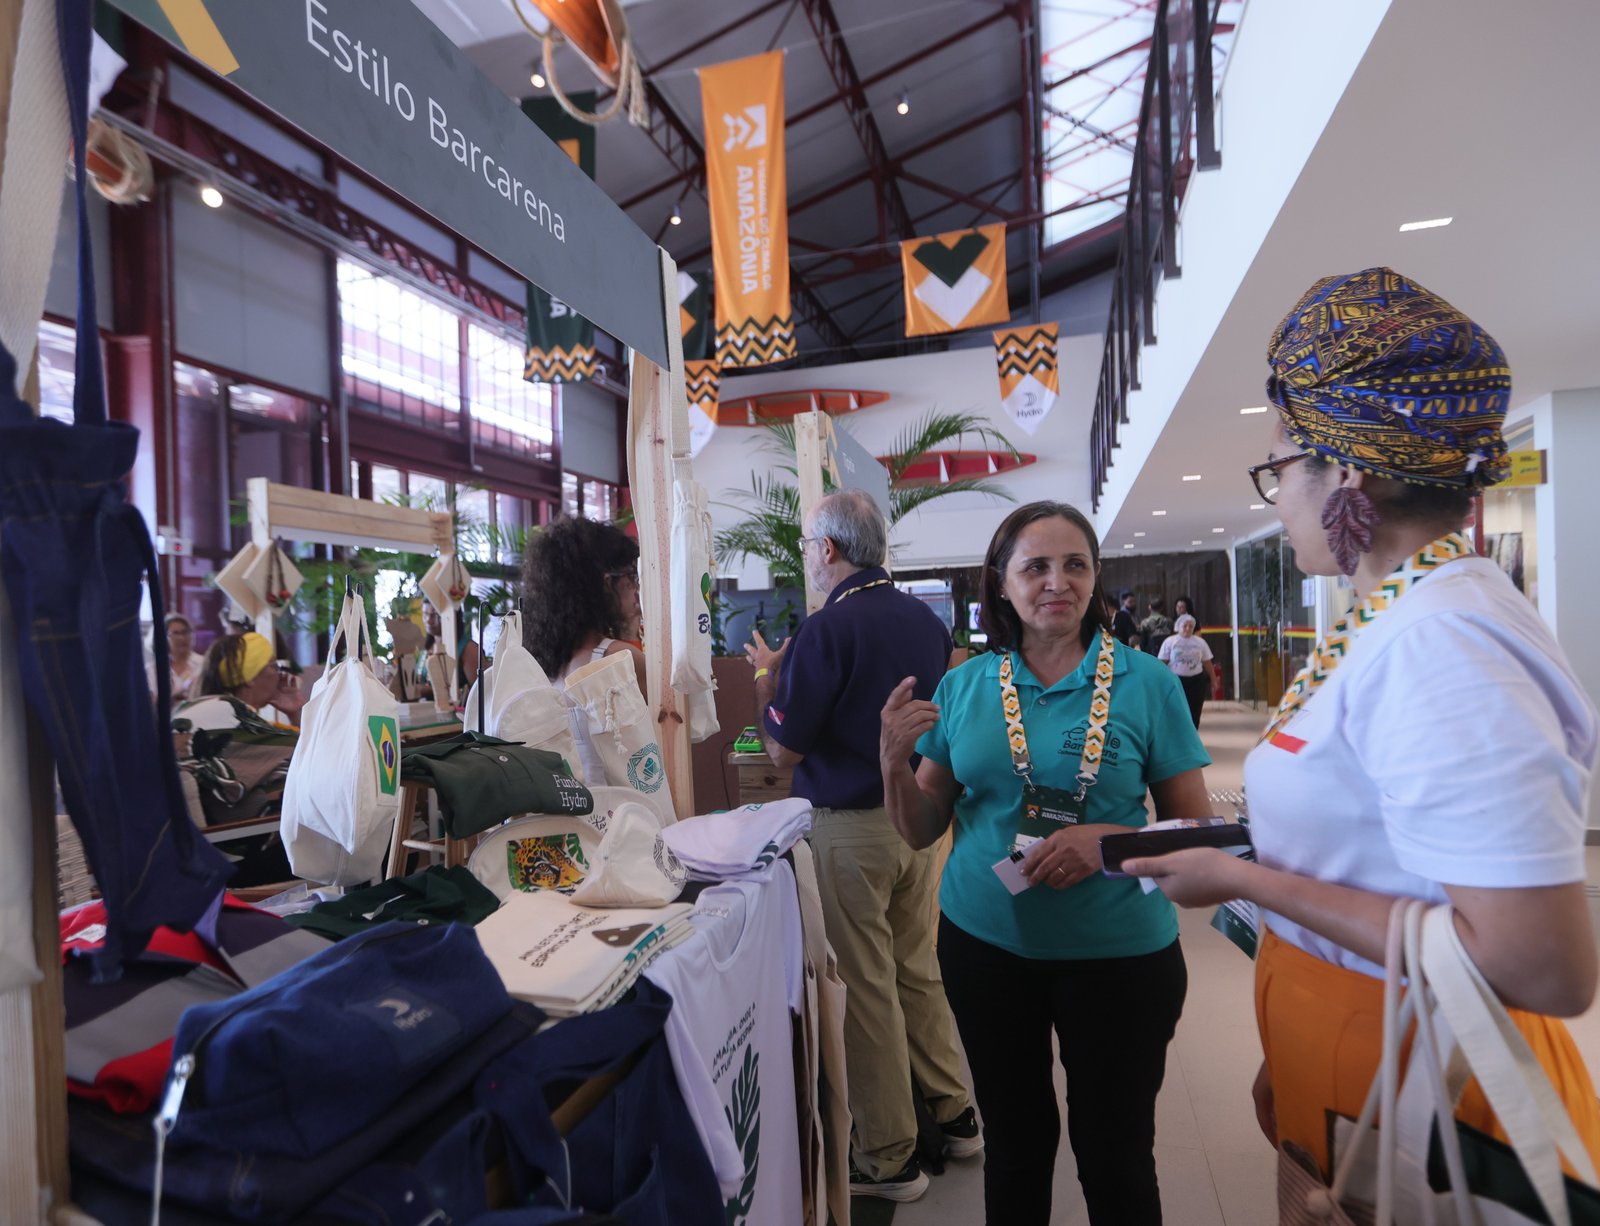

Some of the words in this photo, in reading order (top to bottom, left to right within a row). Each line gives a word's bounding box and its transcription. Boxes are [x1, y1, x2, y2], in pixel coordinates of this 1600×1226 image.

[305, 0, 416, 122] Estilo
[428, 97, 566, 243] Barcarena
[736, 165, 760, 295] AMAZÔNIA
[1017, 407, 1043, 418] Hydro
[560, 791, 588, 811] Hydro
